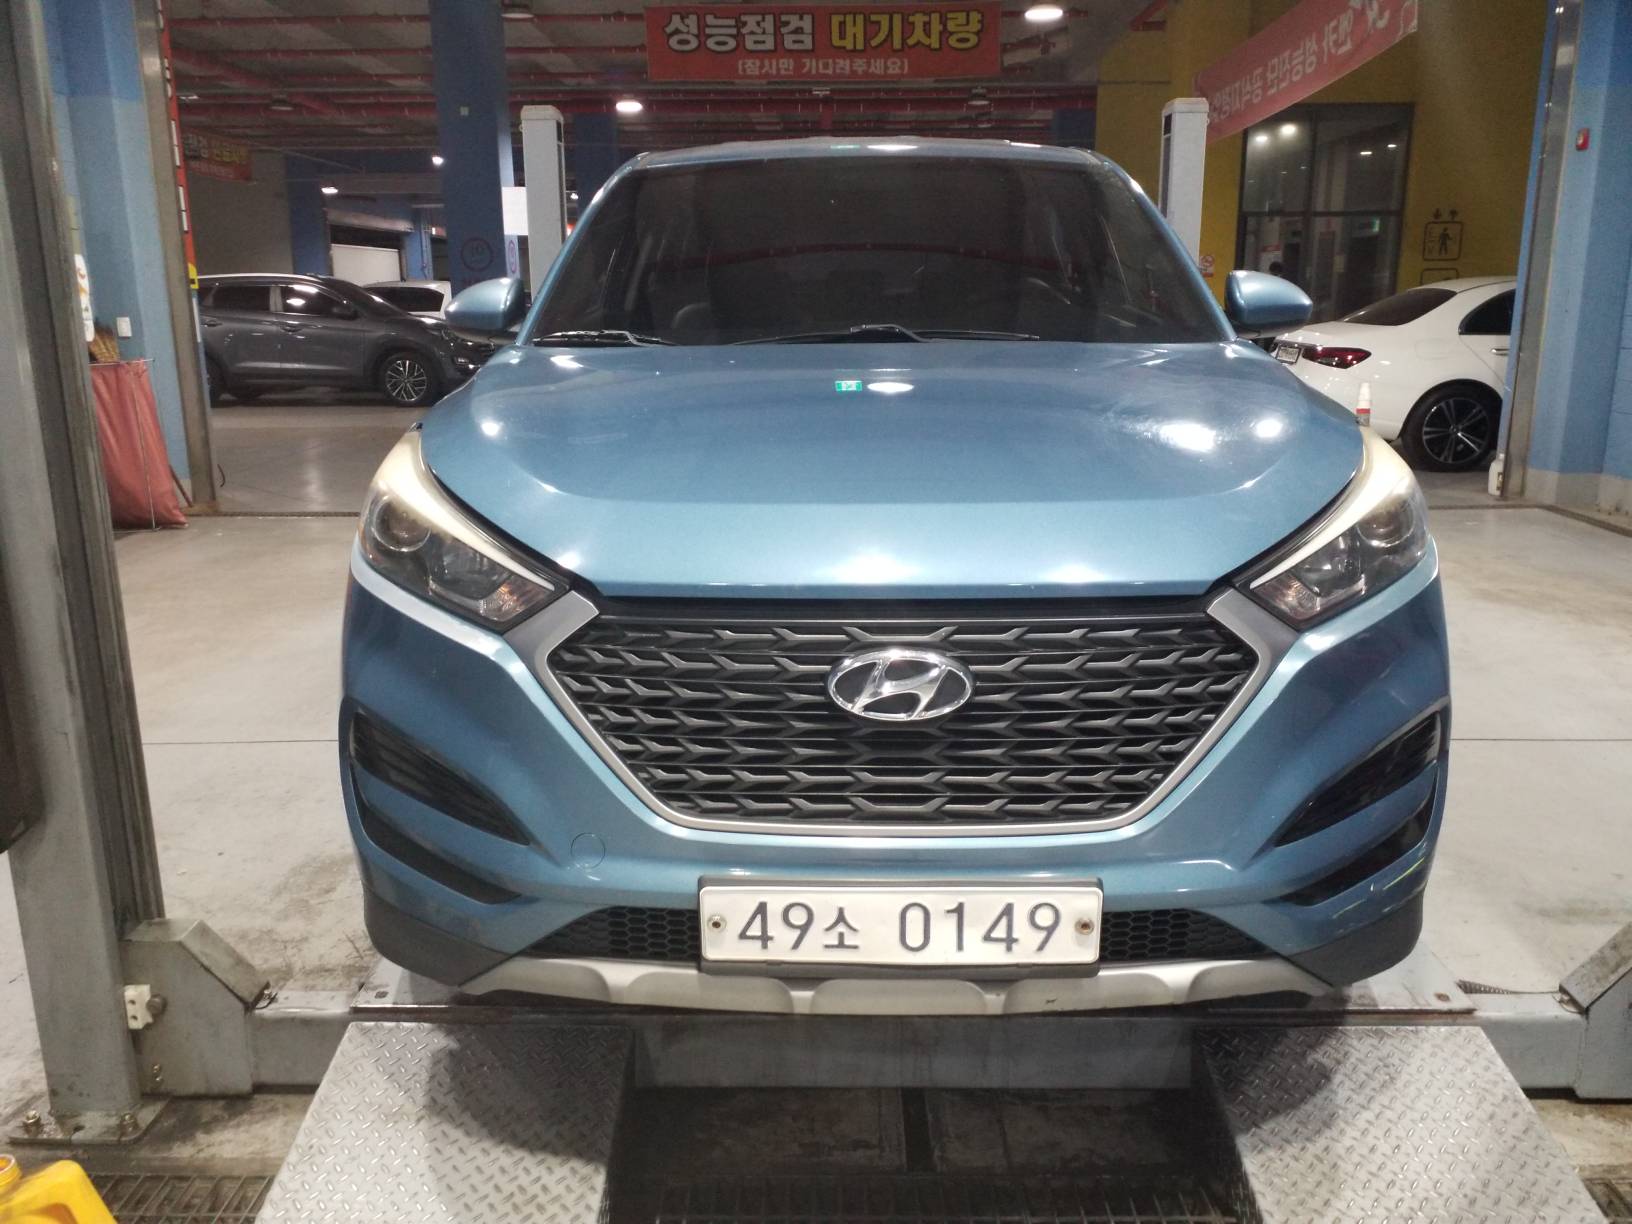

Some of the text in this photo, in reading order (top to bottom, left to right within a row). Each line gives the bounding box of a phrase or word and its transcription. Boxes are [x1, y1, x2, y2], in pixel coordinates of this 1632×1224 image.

[664, 10, 984, 52] 성능점검 대기차량
[738, 57, 909, 76] (잠시만 기다려주세요)
[738, 901, 1062, 953] 49소 0149
